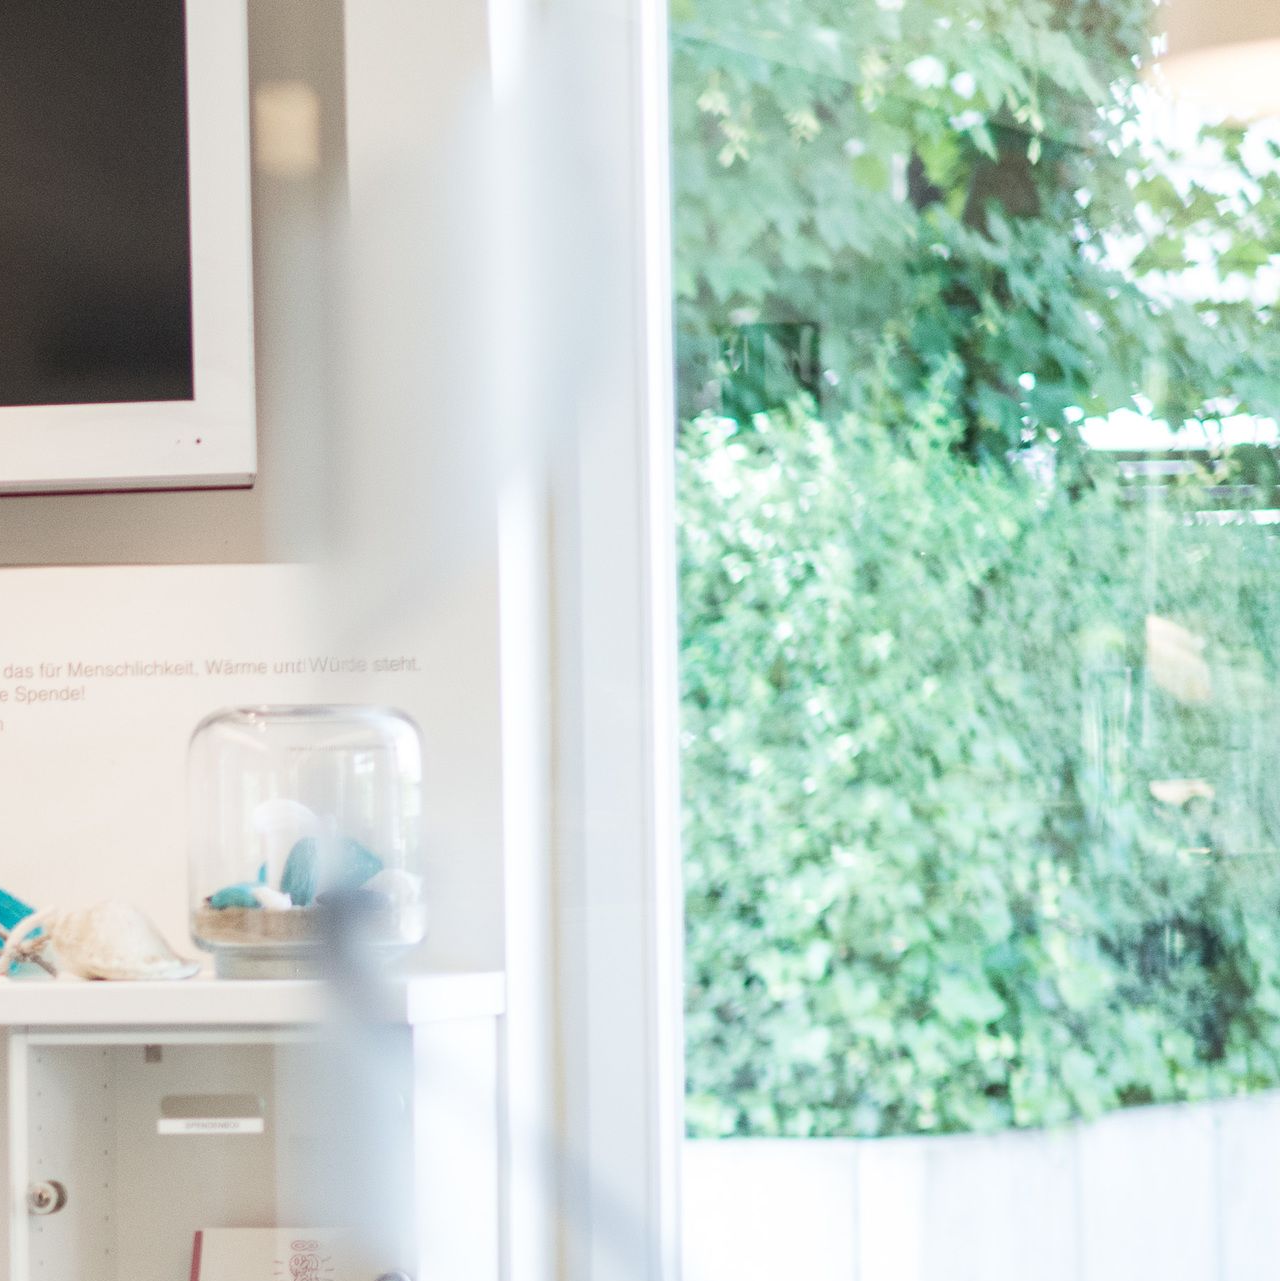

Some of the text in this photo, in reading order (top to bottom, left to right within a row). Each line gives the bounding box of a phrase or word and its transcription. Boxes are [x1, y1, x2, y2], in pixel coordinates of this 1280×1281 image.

[4, 661, 34, 679] das
[39, 661, 62, 678] für
[205, 659, 267, 675] Wärme
[274, 657, 305, 675] und
[373, 655, 421, 672] steht.
[14, 685, 85, 705] Spende!
